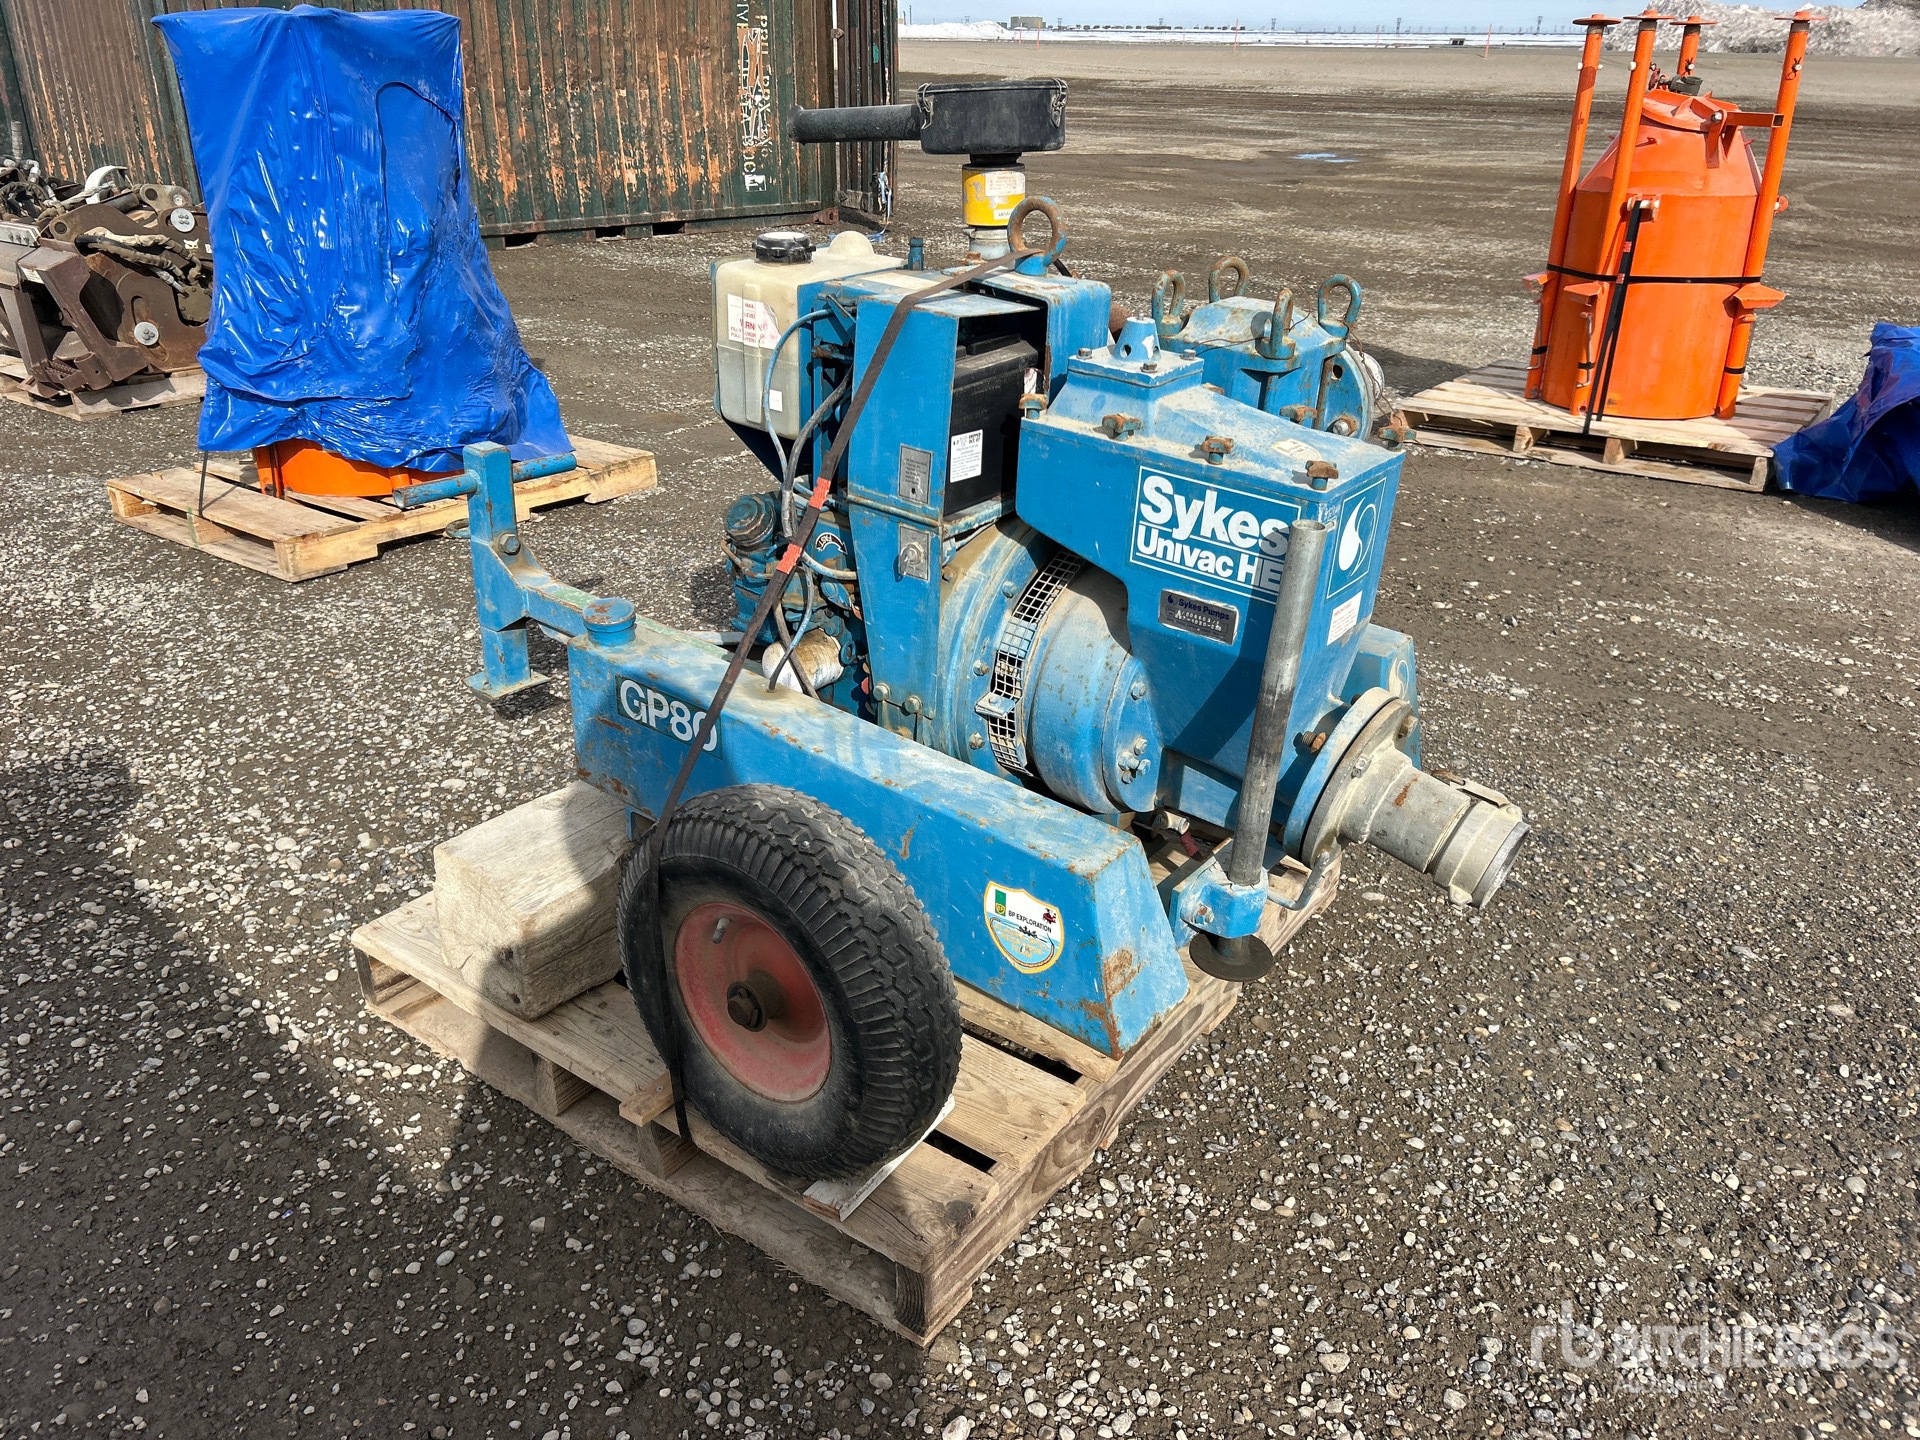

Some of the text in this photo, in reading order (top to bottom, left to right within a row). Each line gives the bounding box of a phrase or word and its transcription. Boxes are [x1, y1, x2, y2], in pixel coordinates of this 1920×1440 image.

[1140, 475, 1290, 557] Sykes
[1136, 525, 1234, 578] Univac
[1178, 598, 1202, 612] Sykes
[1203, 606, 1230, 621] Pumps
[1016, 913, 1052, 933] EXPLORATION
